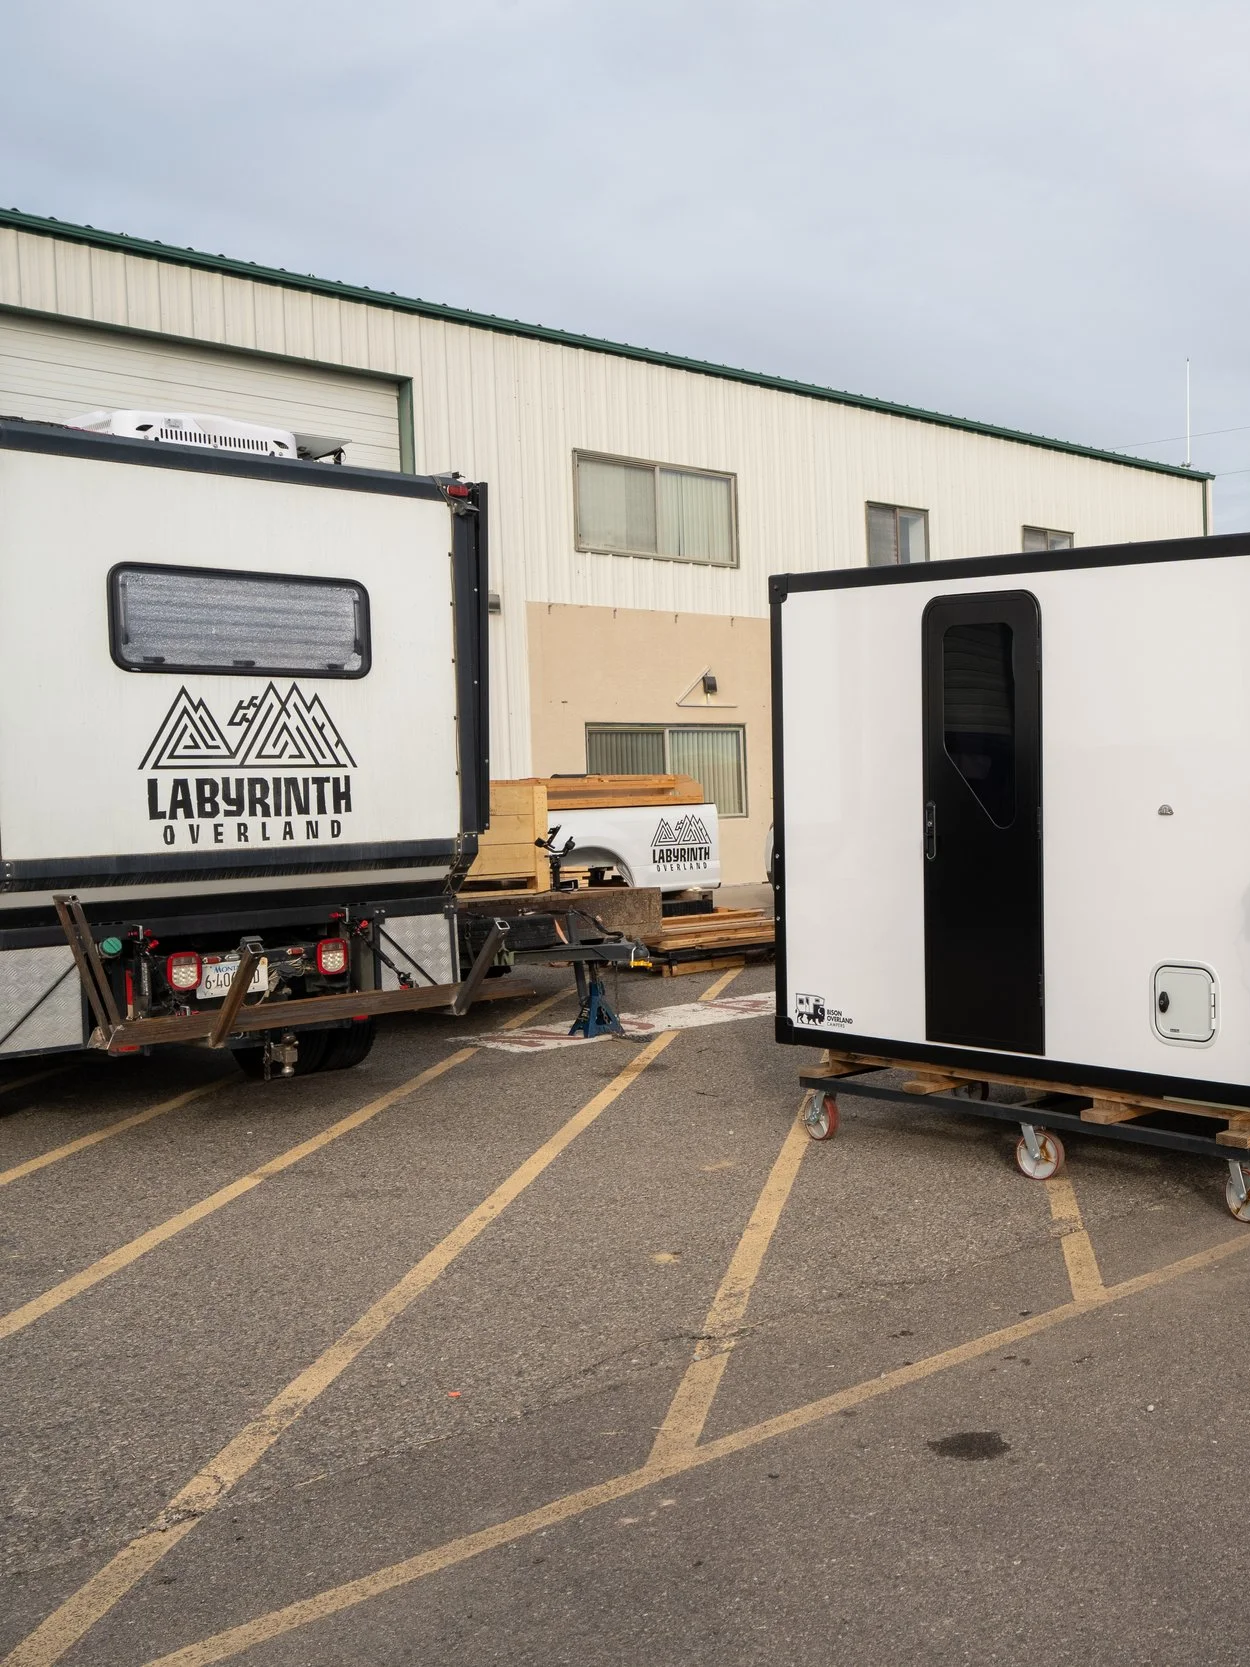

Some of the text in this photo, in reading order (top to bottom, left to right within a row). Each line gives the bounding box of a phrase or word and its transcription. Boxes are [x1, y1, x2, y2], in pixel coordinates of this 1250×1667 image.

[147, 775, 352, 820] LABYRINTH
[162, 819, 342, 845] OVERLAND
[652, 846, 710, 864] LABYRINTH
[656, 861, 708, 872] OVERLAND
[826, 1009, 843, 1017] BISON
[826, 1015, 853, 1025] OVERLAND
[826, 1021, 846, 1029] CAMPERS
